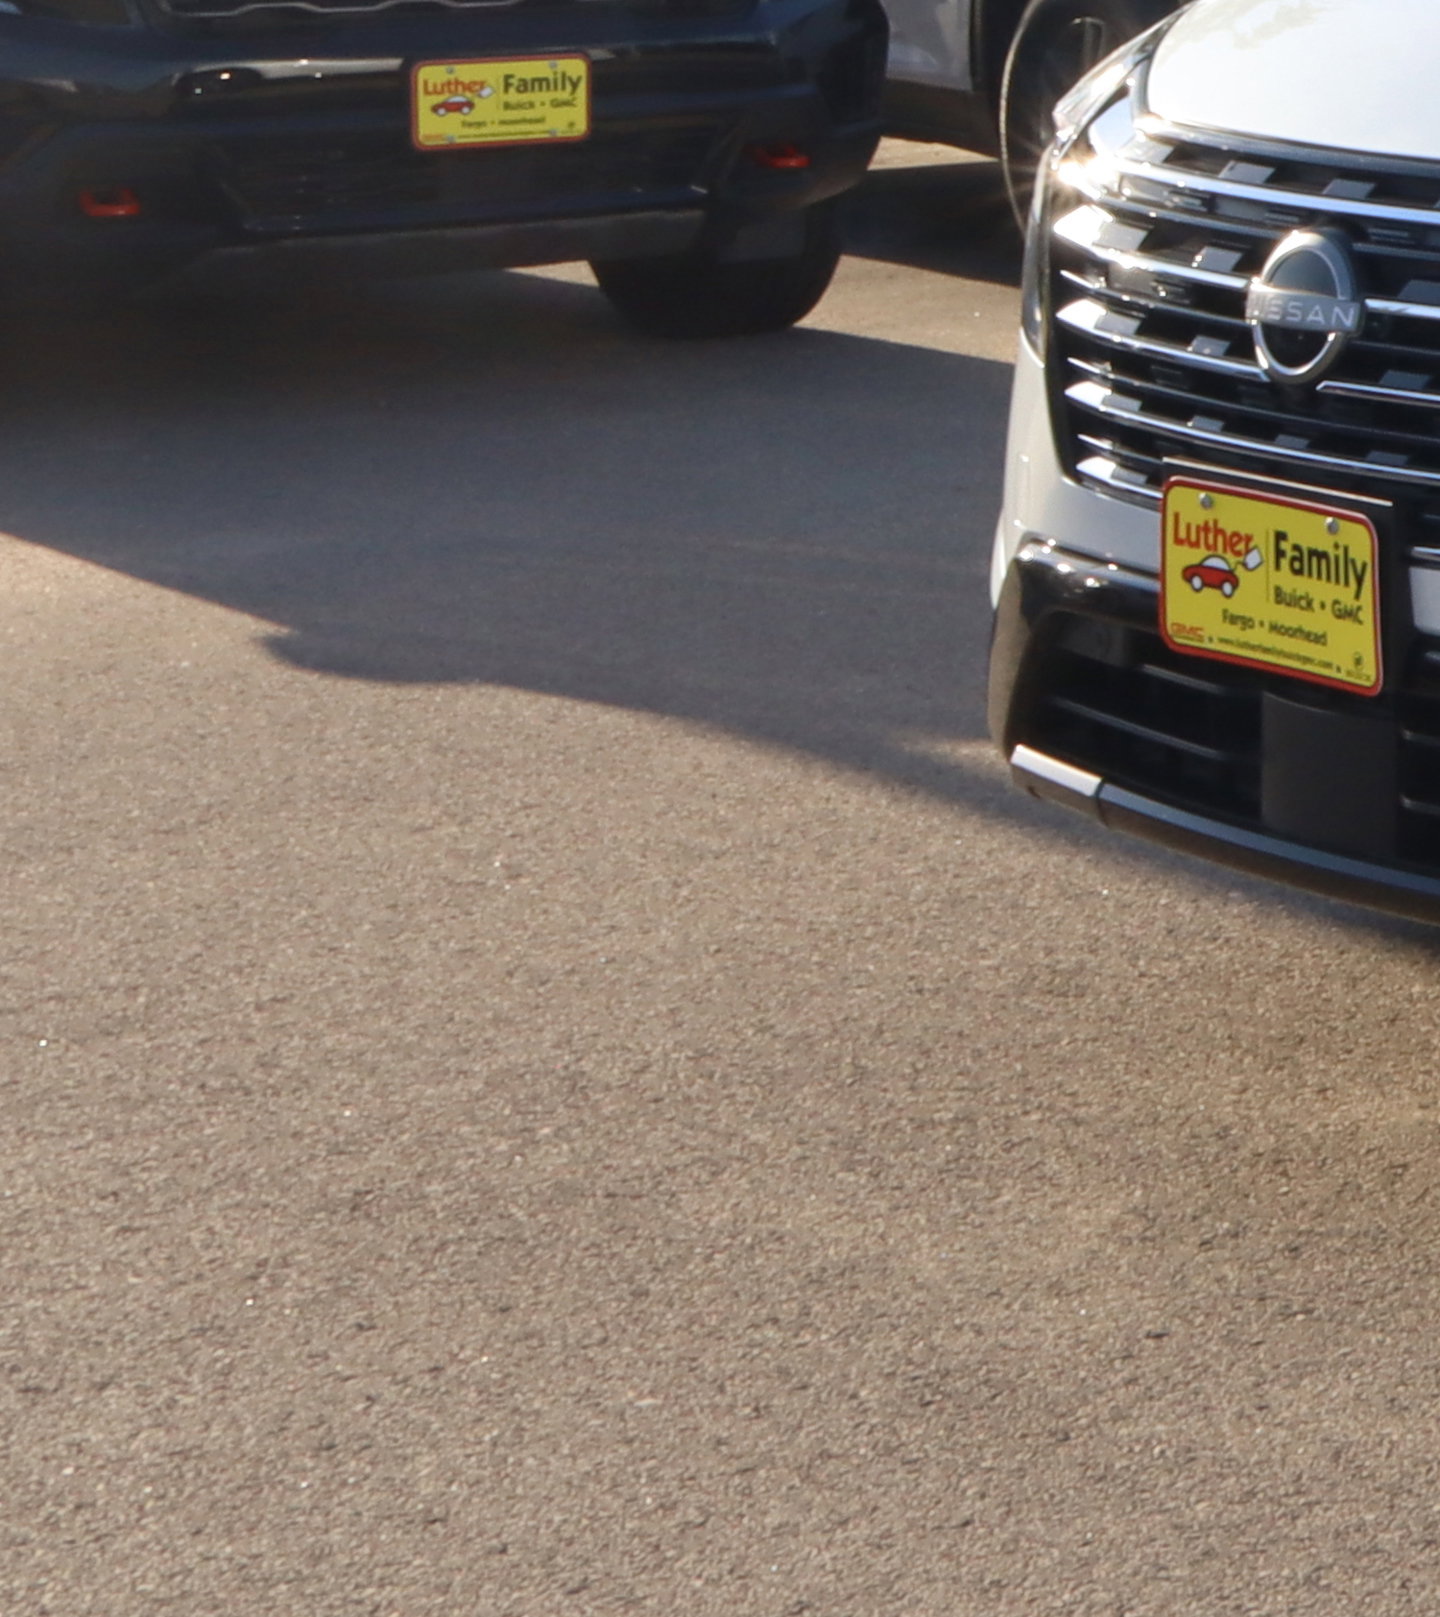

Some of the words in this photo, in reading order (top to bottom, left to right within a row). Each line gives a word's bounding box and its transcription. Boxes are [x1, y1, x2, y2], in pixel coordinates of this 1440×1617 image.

[422, 77, 488, 96] Luther
[503, 71, 582, 95] Family
[503, 100, 536, 111] Buick
[1172, 511, 1254, 557] Luther
[1273, 530, 1368, 600] Family
[1273, 585, 1315, 613] Buick
[1331, 599, 1364, 625] GMC
[1221, 608, 1255, 631] Fargo
[1268, 620, 1328, 646] Moorhead
